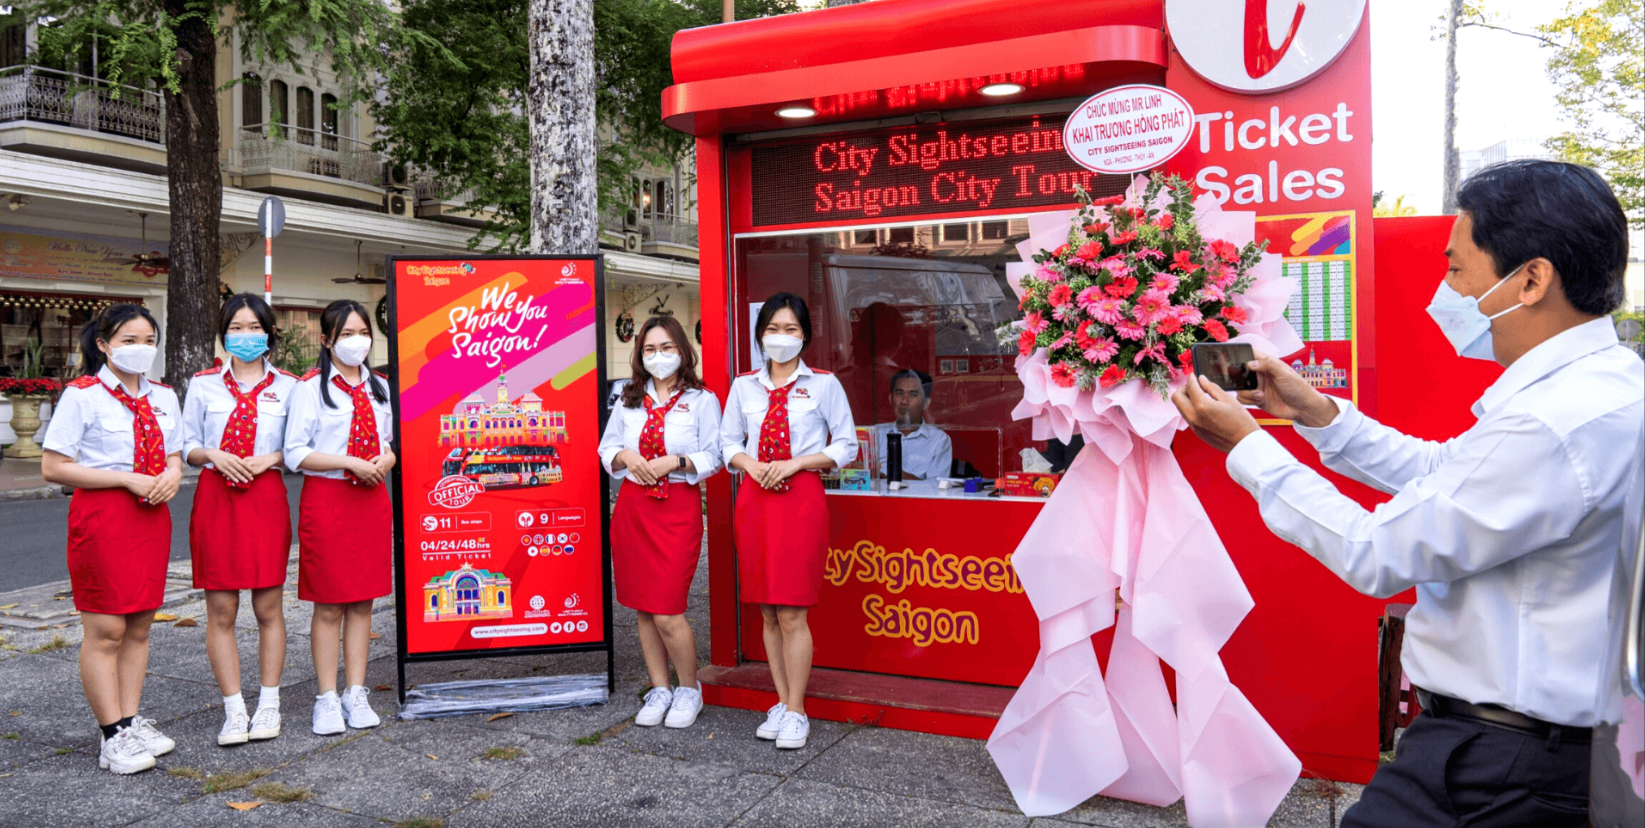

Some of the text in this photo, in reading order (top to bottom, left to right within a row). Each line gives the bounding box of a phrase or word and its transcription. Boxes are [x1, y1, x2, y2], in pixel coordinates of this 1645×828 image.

[1131, 97, 1144, 111] MR
[1145, 94, 1162, 110] LINH
[1072, 126, 1094, 145] KHAI
[1161, 108, 1185, 130] PHÁT
[1194, 102, 1354, 154] Ticket
[815, 121, 1064, 176] City Sightseein
[1087, 136, 1173, 156] CITY SIGHTSEEING SAIGON
[815, 164, 1098, 216] Saigon City Tour
[1196, 160, 1346, 206] Sales
[481, 281, 517, 311] We
[448, 306, 511, 333] Show
[451, 324, 548, 368] Saigon!
[433, 484, 481, 502] OFFICIAL
[449, 495, 471, 506] TOUR
[440, 517, 451, 529] 11
[540, 513, 549, 524] 9
[458, 552, 492, 560] Ticket
[474, 626, 544, 635] www.citysightseeing.com
[862, 593, 979, 647] Saigon
